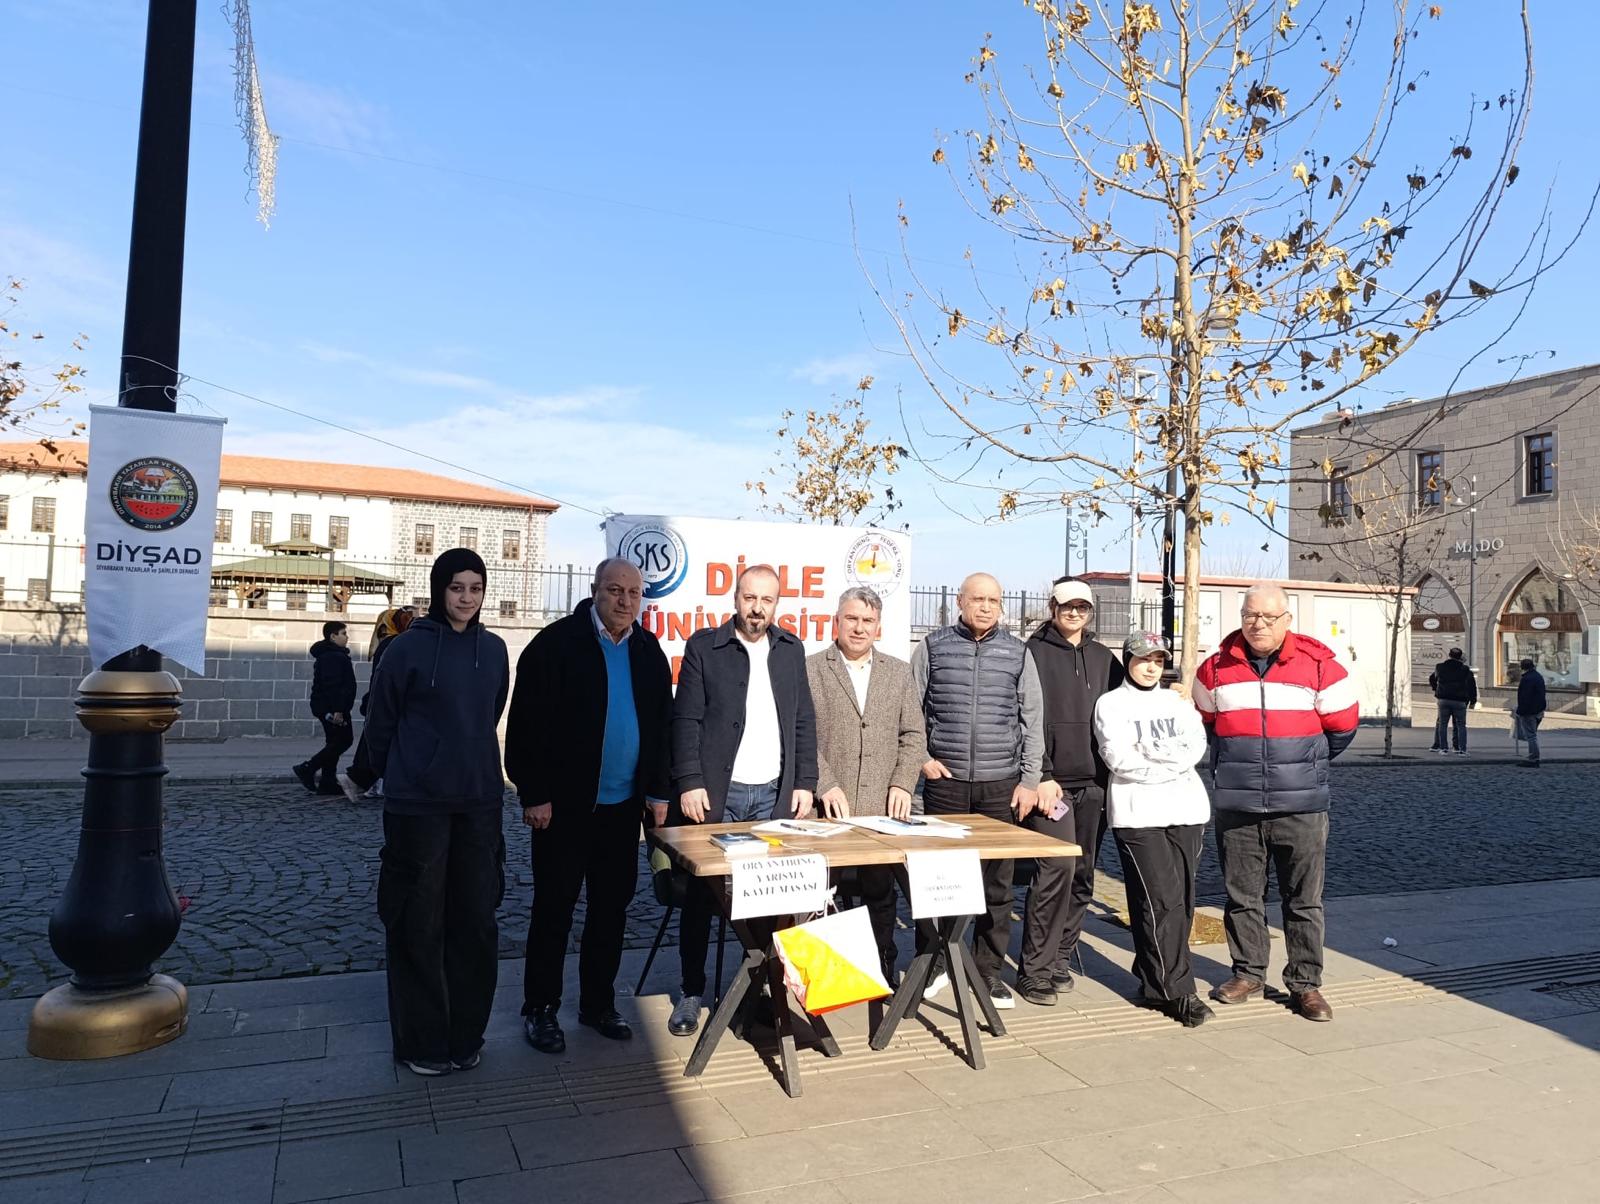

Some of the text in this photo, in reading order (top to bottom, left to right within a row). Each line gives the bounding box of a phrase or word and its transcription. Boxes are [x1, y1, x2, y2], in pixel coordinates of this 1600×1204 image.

[97, 540, 201, 568] DİYŞAD
[634, 542, 671, 572] SKS
[706, 555, 825, 598] DİLE
